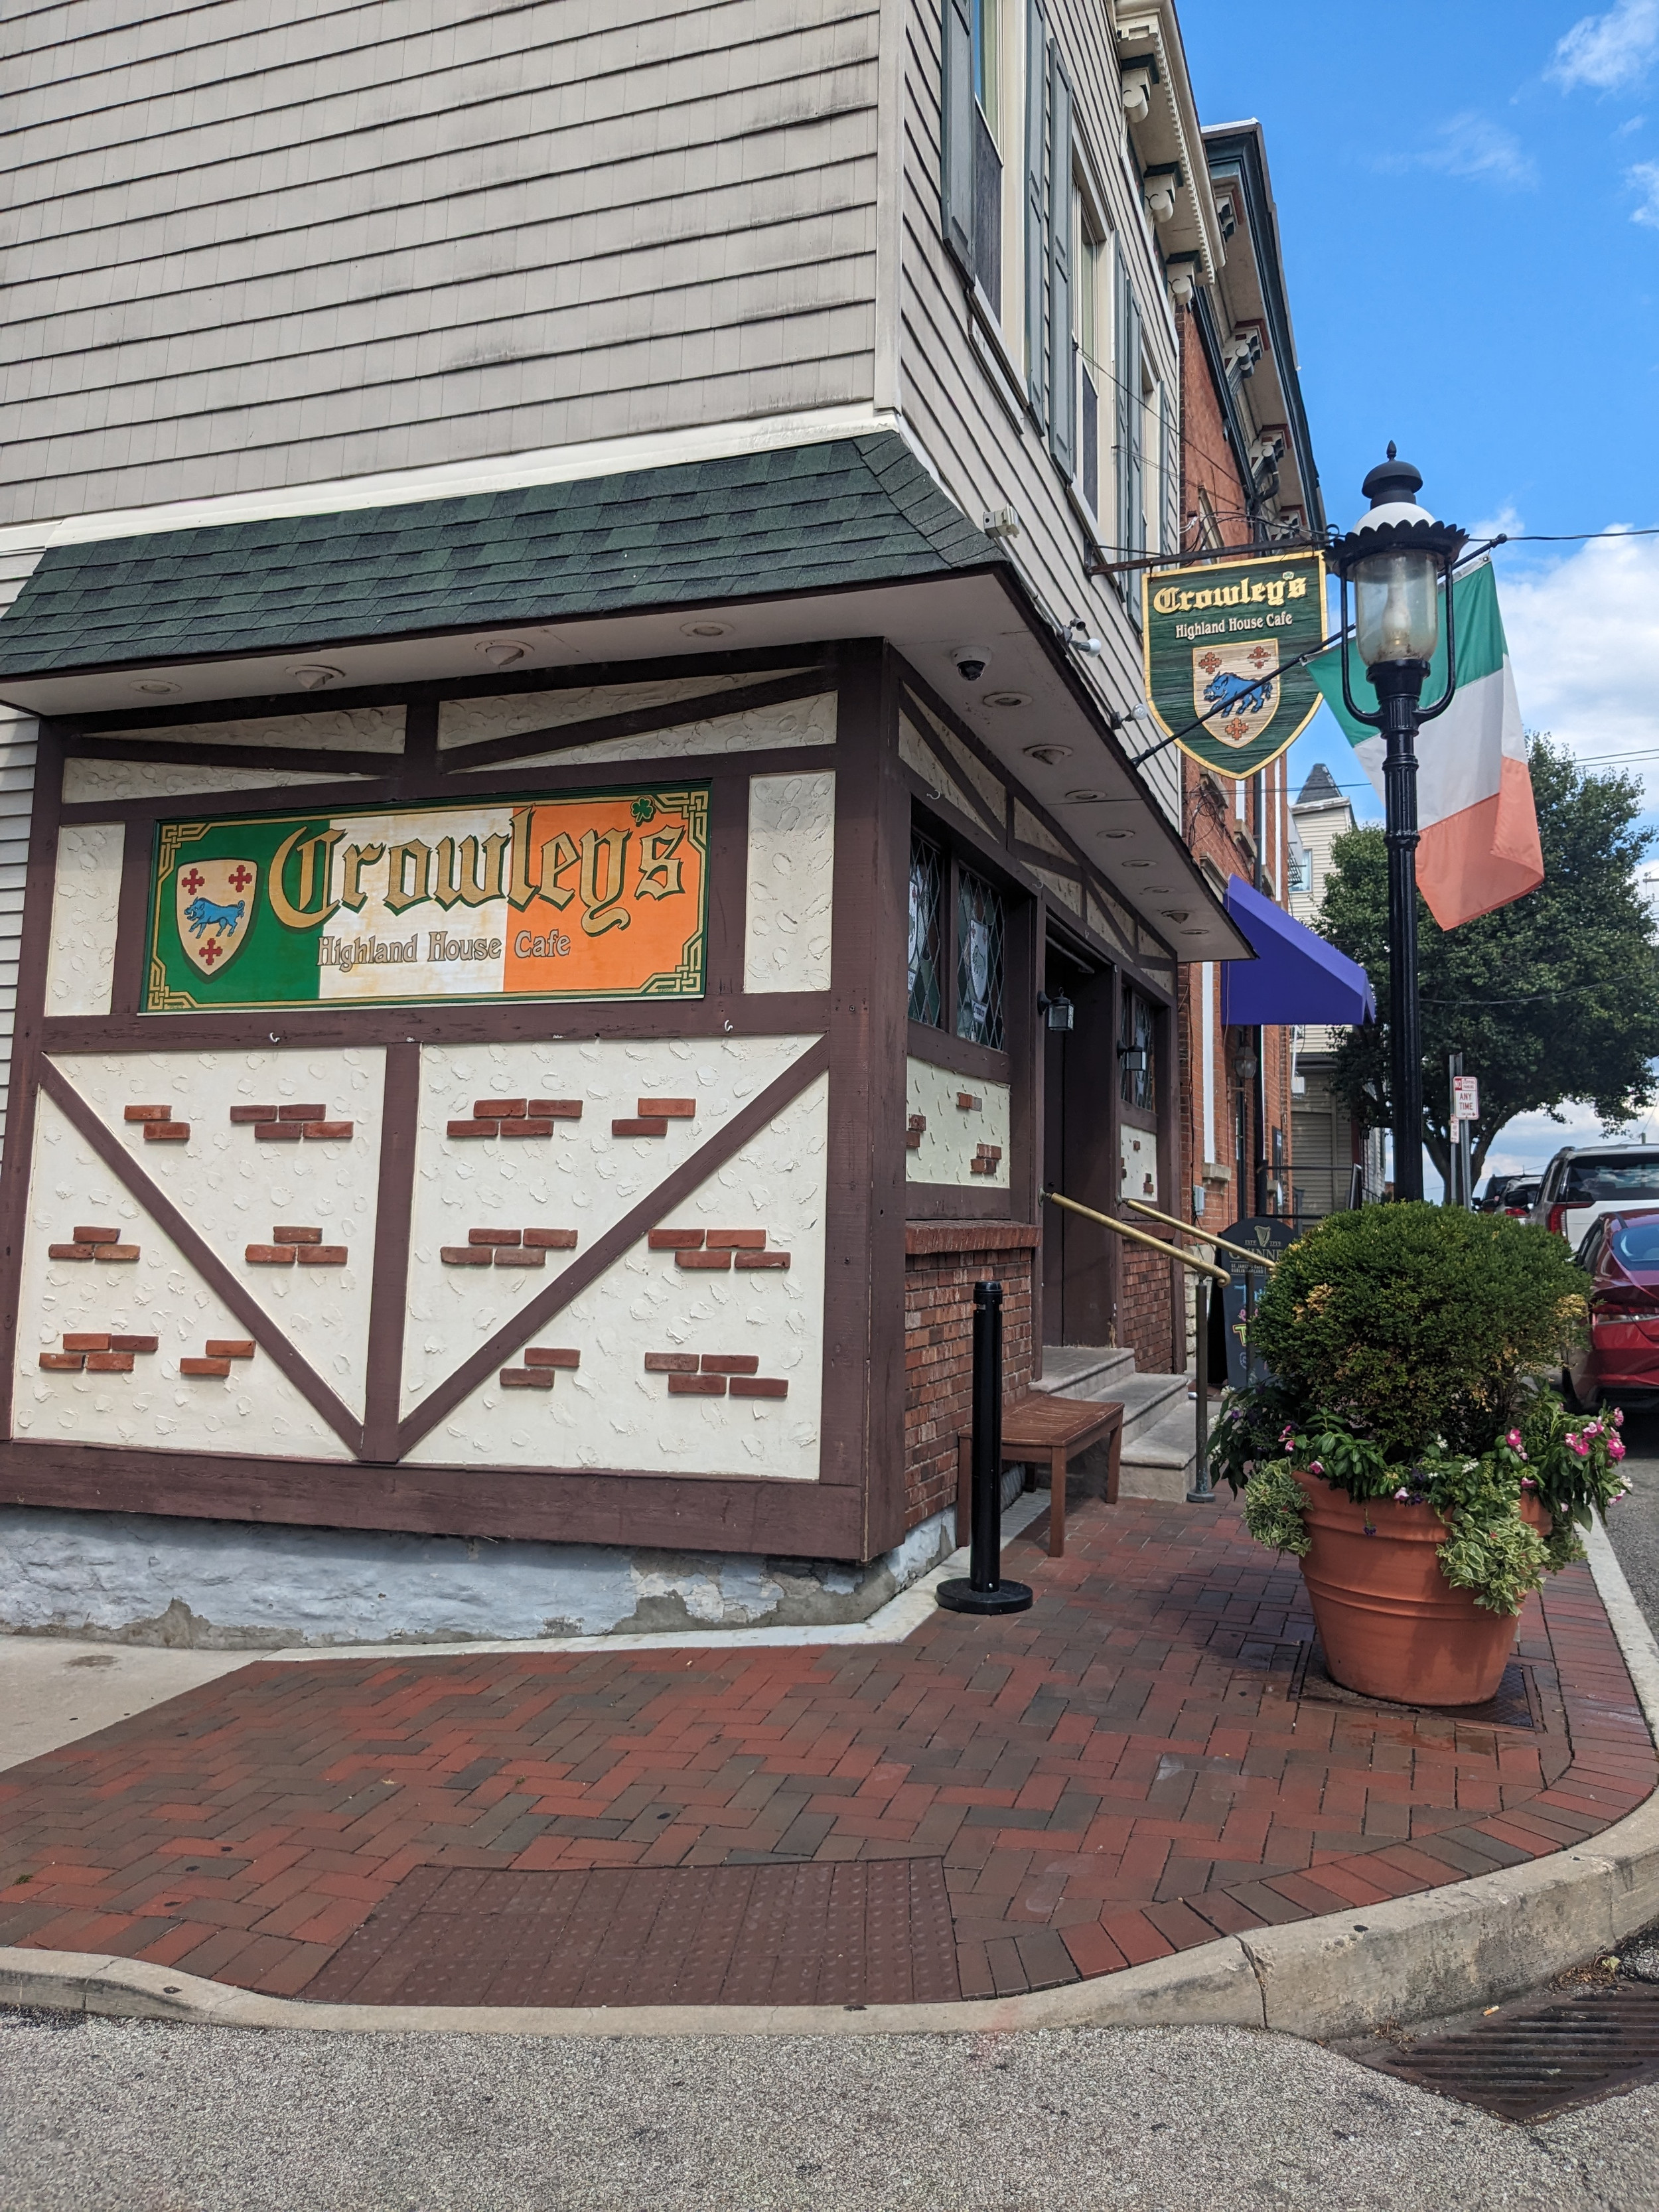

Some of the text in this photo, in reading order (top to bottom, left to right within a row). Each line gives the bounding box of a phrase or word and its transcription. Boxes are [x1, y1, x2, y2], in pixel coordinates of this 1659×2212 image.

[1176, 611, 1293, 640] Highland House Cafe
[315, 929, 571, 972] Highland House Cafe
